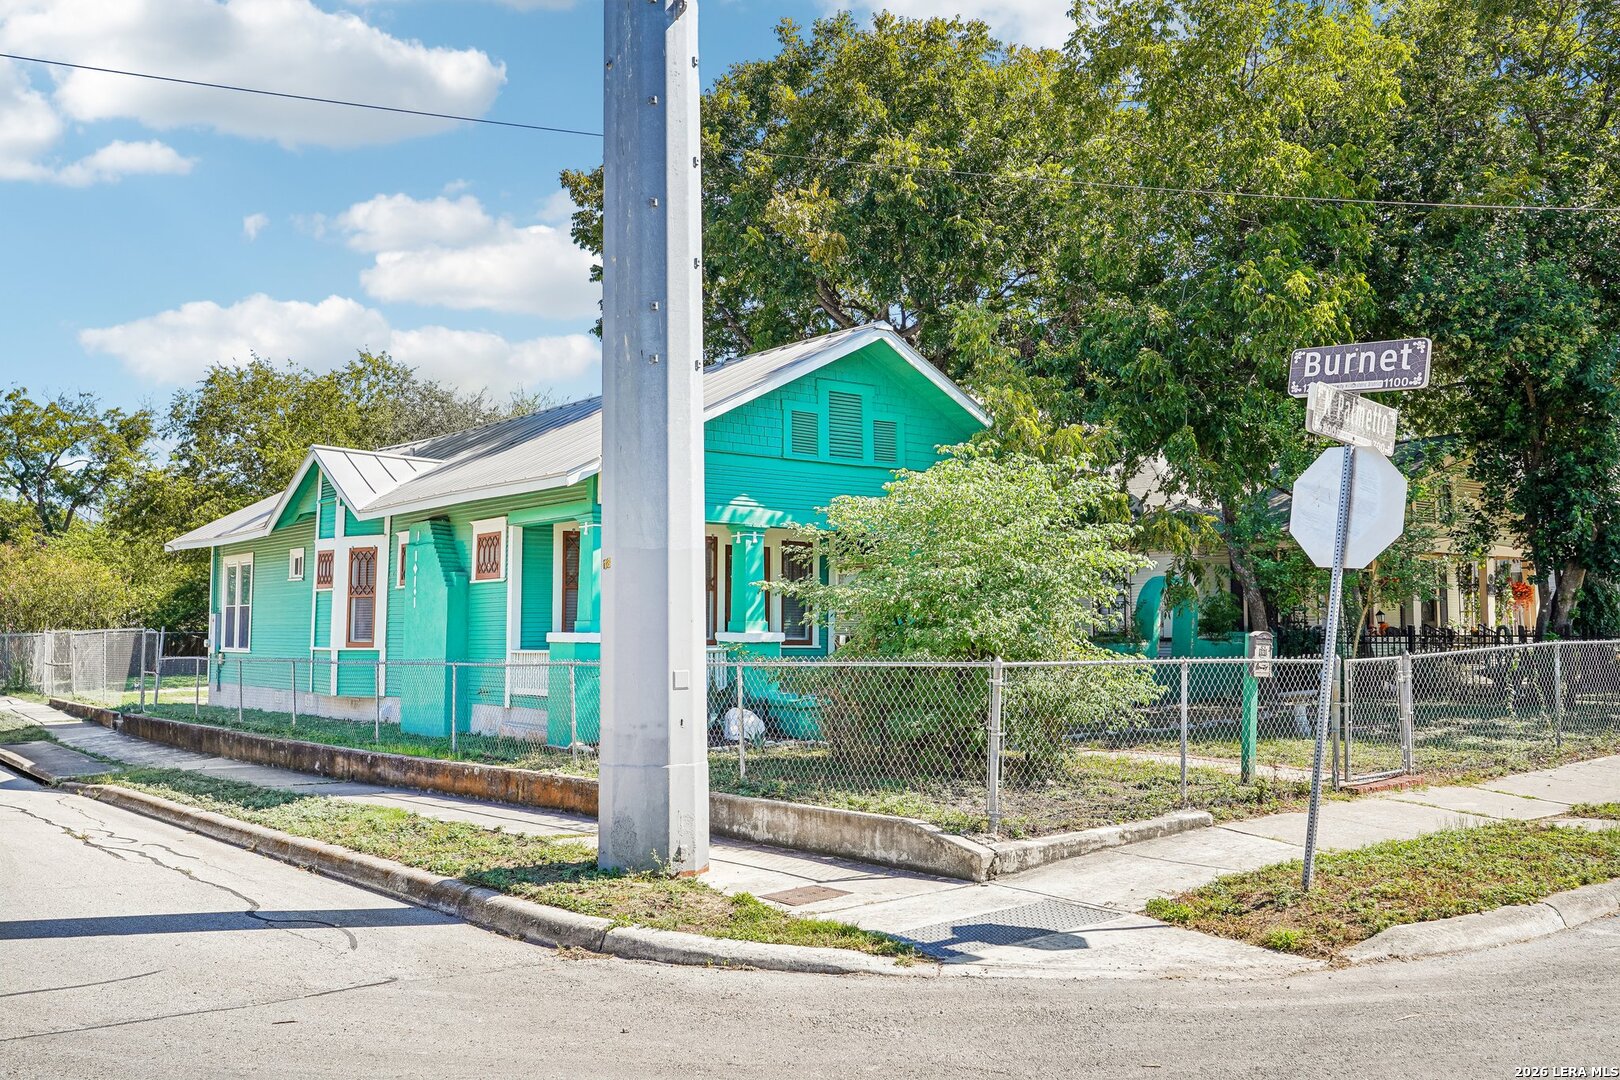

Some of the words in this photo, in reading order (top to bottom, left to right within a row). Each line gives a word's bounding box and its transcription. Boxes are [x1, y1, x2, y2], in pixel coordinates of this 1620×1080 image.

[1304, 343, 1413, 377] Burnet
[1383, 377, 1409, 388] 1100
[1337, 394, 1388, 436] Palmetto
